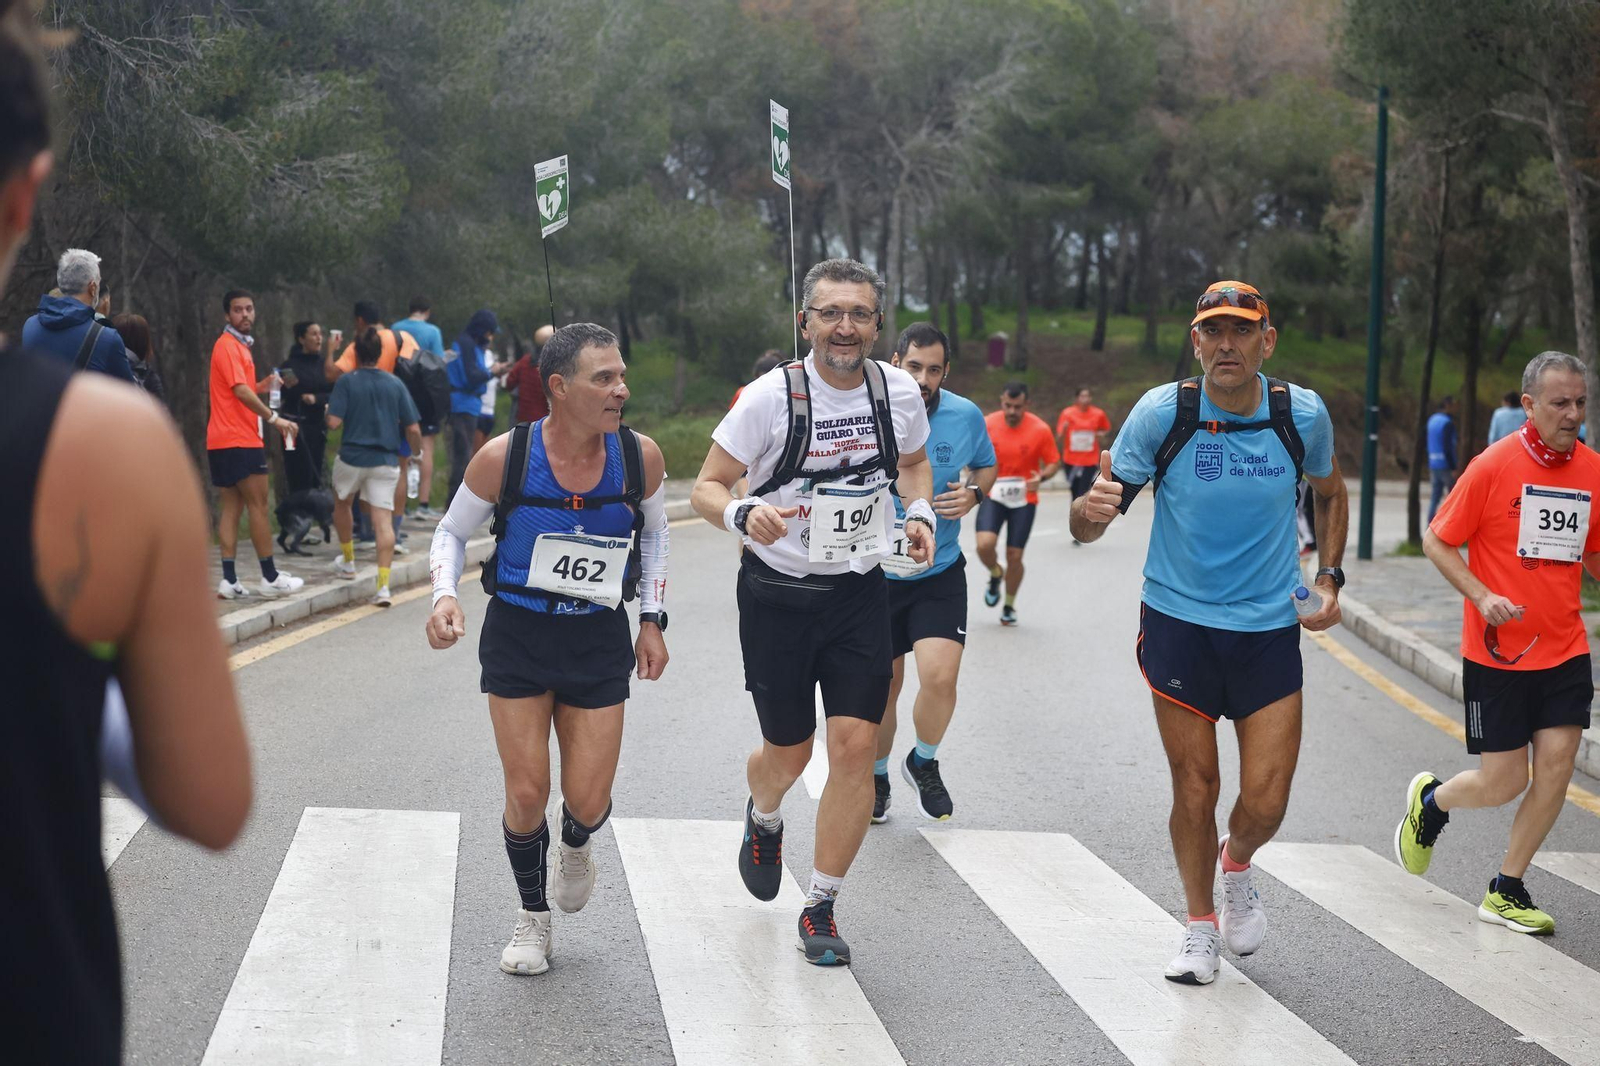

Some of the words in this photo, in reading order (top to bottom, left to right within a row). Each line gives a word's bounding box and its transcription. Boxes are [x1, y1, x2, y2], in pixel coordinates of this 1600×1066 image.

[814, 416, 874, 430] SOLIDARIA
[816, 428, 853, 441] GUARO
[1229, 453, 1269, 464] Ciudad
[1229, 466, 1244, 476] de
[1247, 466, 1286, 477] Málaga
[833, 504, 873, 533] 190
[1538, 509, 1579, 533] 394
[552, 555, 607, 583] 462
